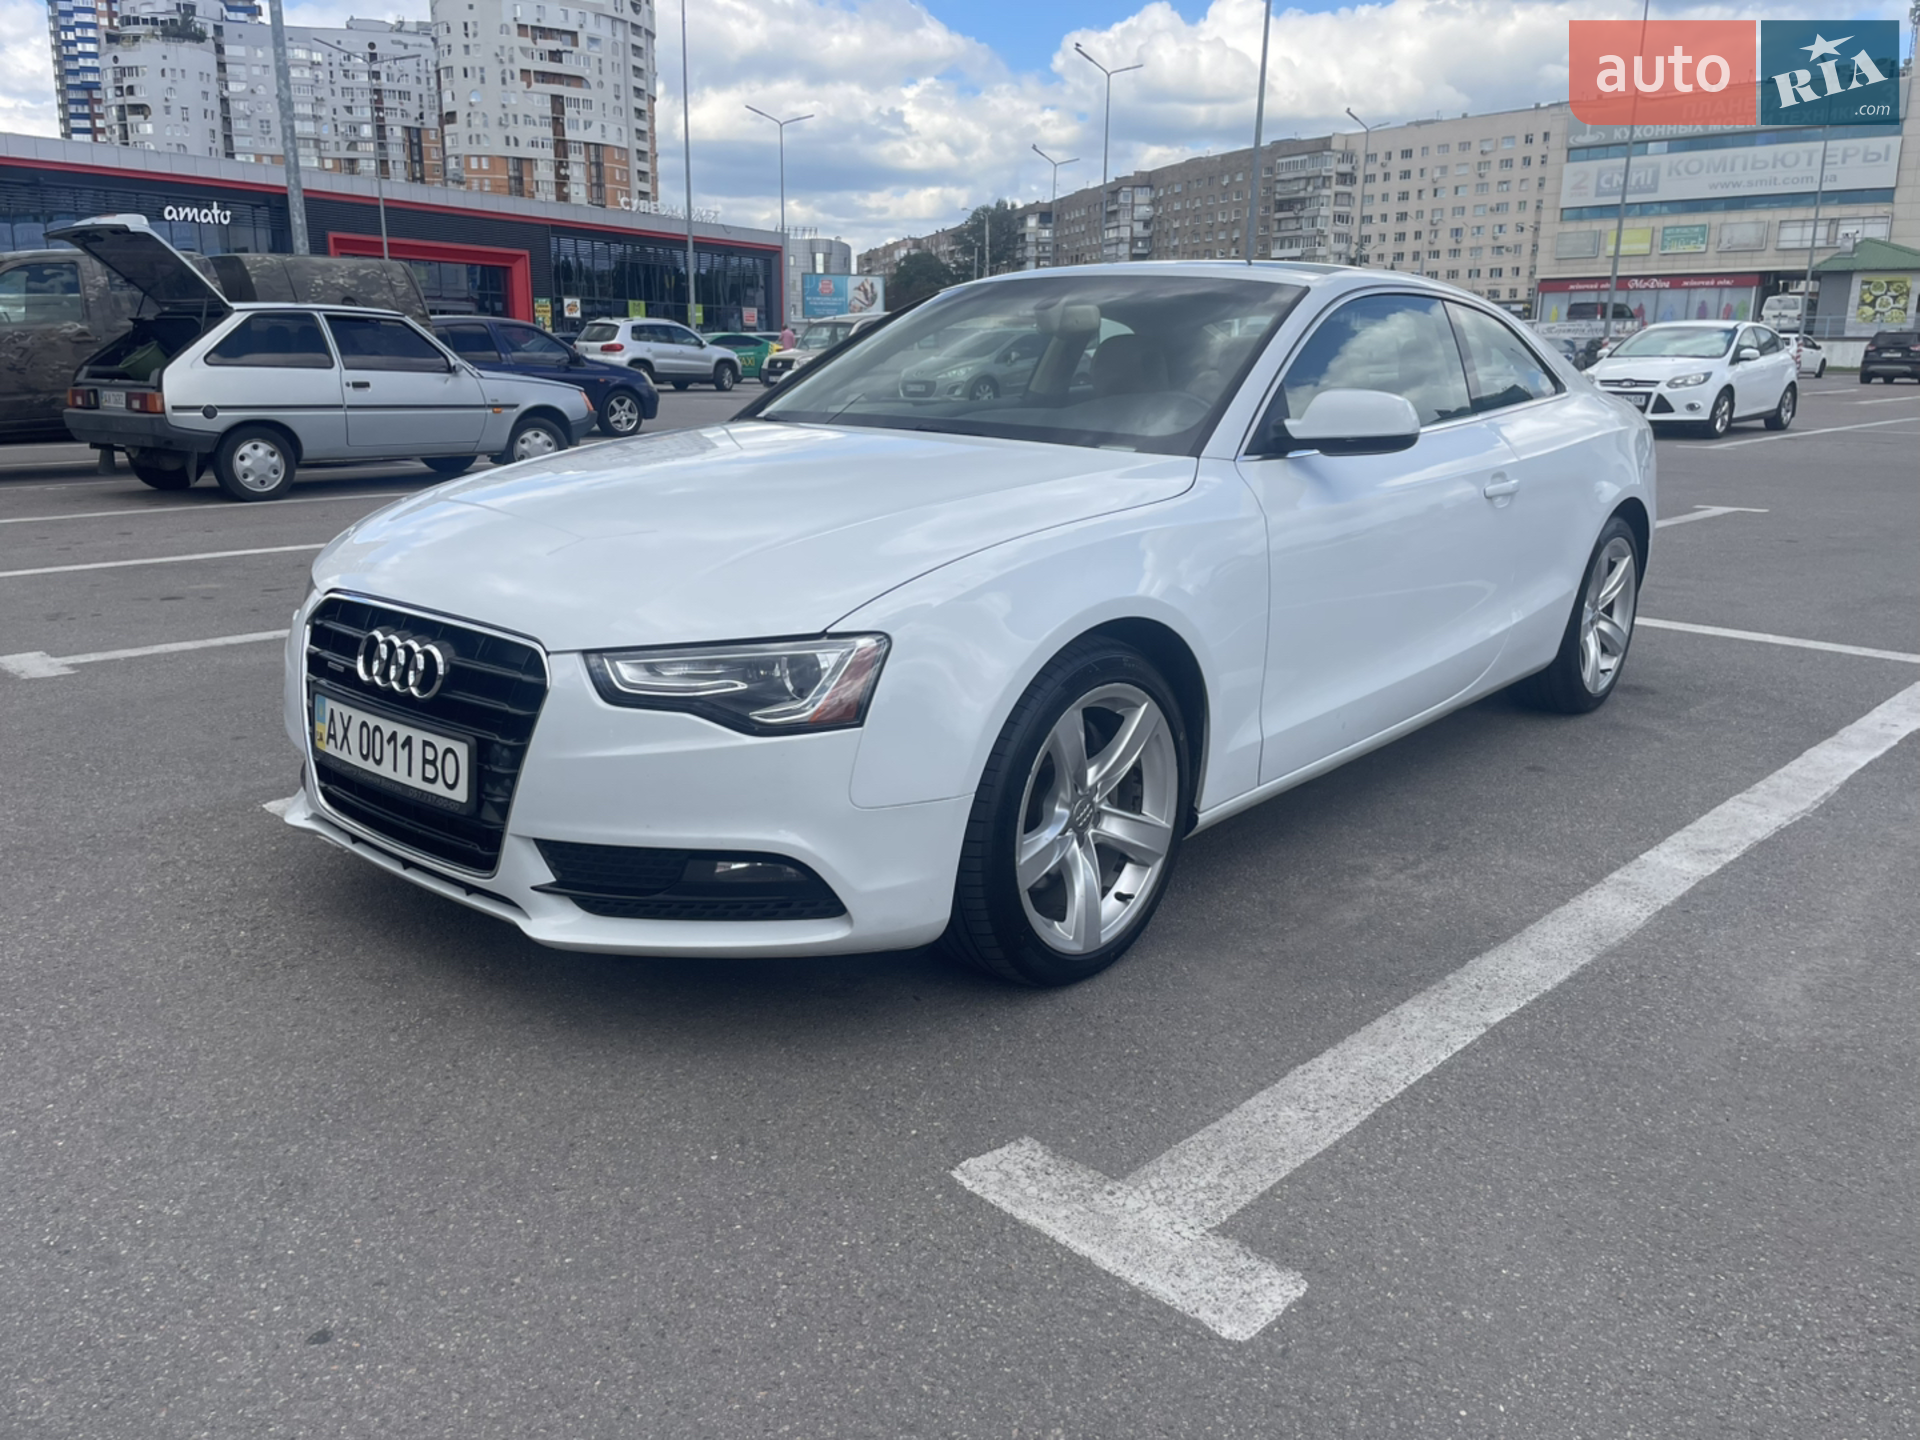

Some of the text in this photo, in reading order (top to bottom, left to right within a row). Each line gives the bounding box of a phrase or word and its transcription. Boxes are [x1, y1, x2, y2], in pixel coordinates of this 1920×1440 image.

[1613, 119, 1705, 141] КУХОННЫХ
[1667, 144, 1891, 177] КОМПЬЮТЕРЫ
[1570, 170, 1590, 190] 2
[163, 201, 232, 225] amato
[326, 708, 460, 791] AX 0011 BO
